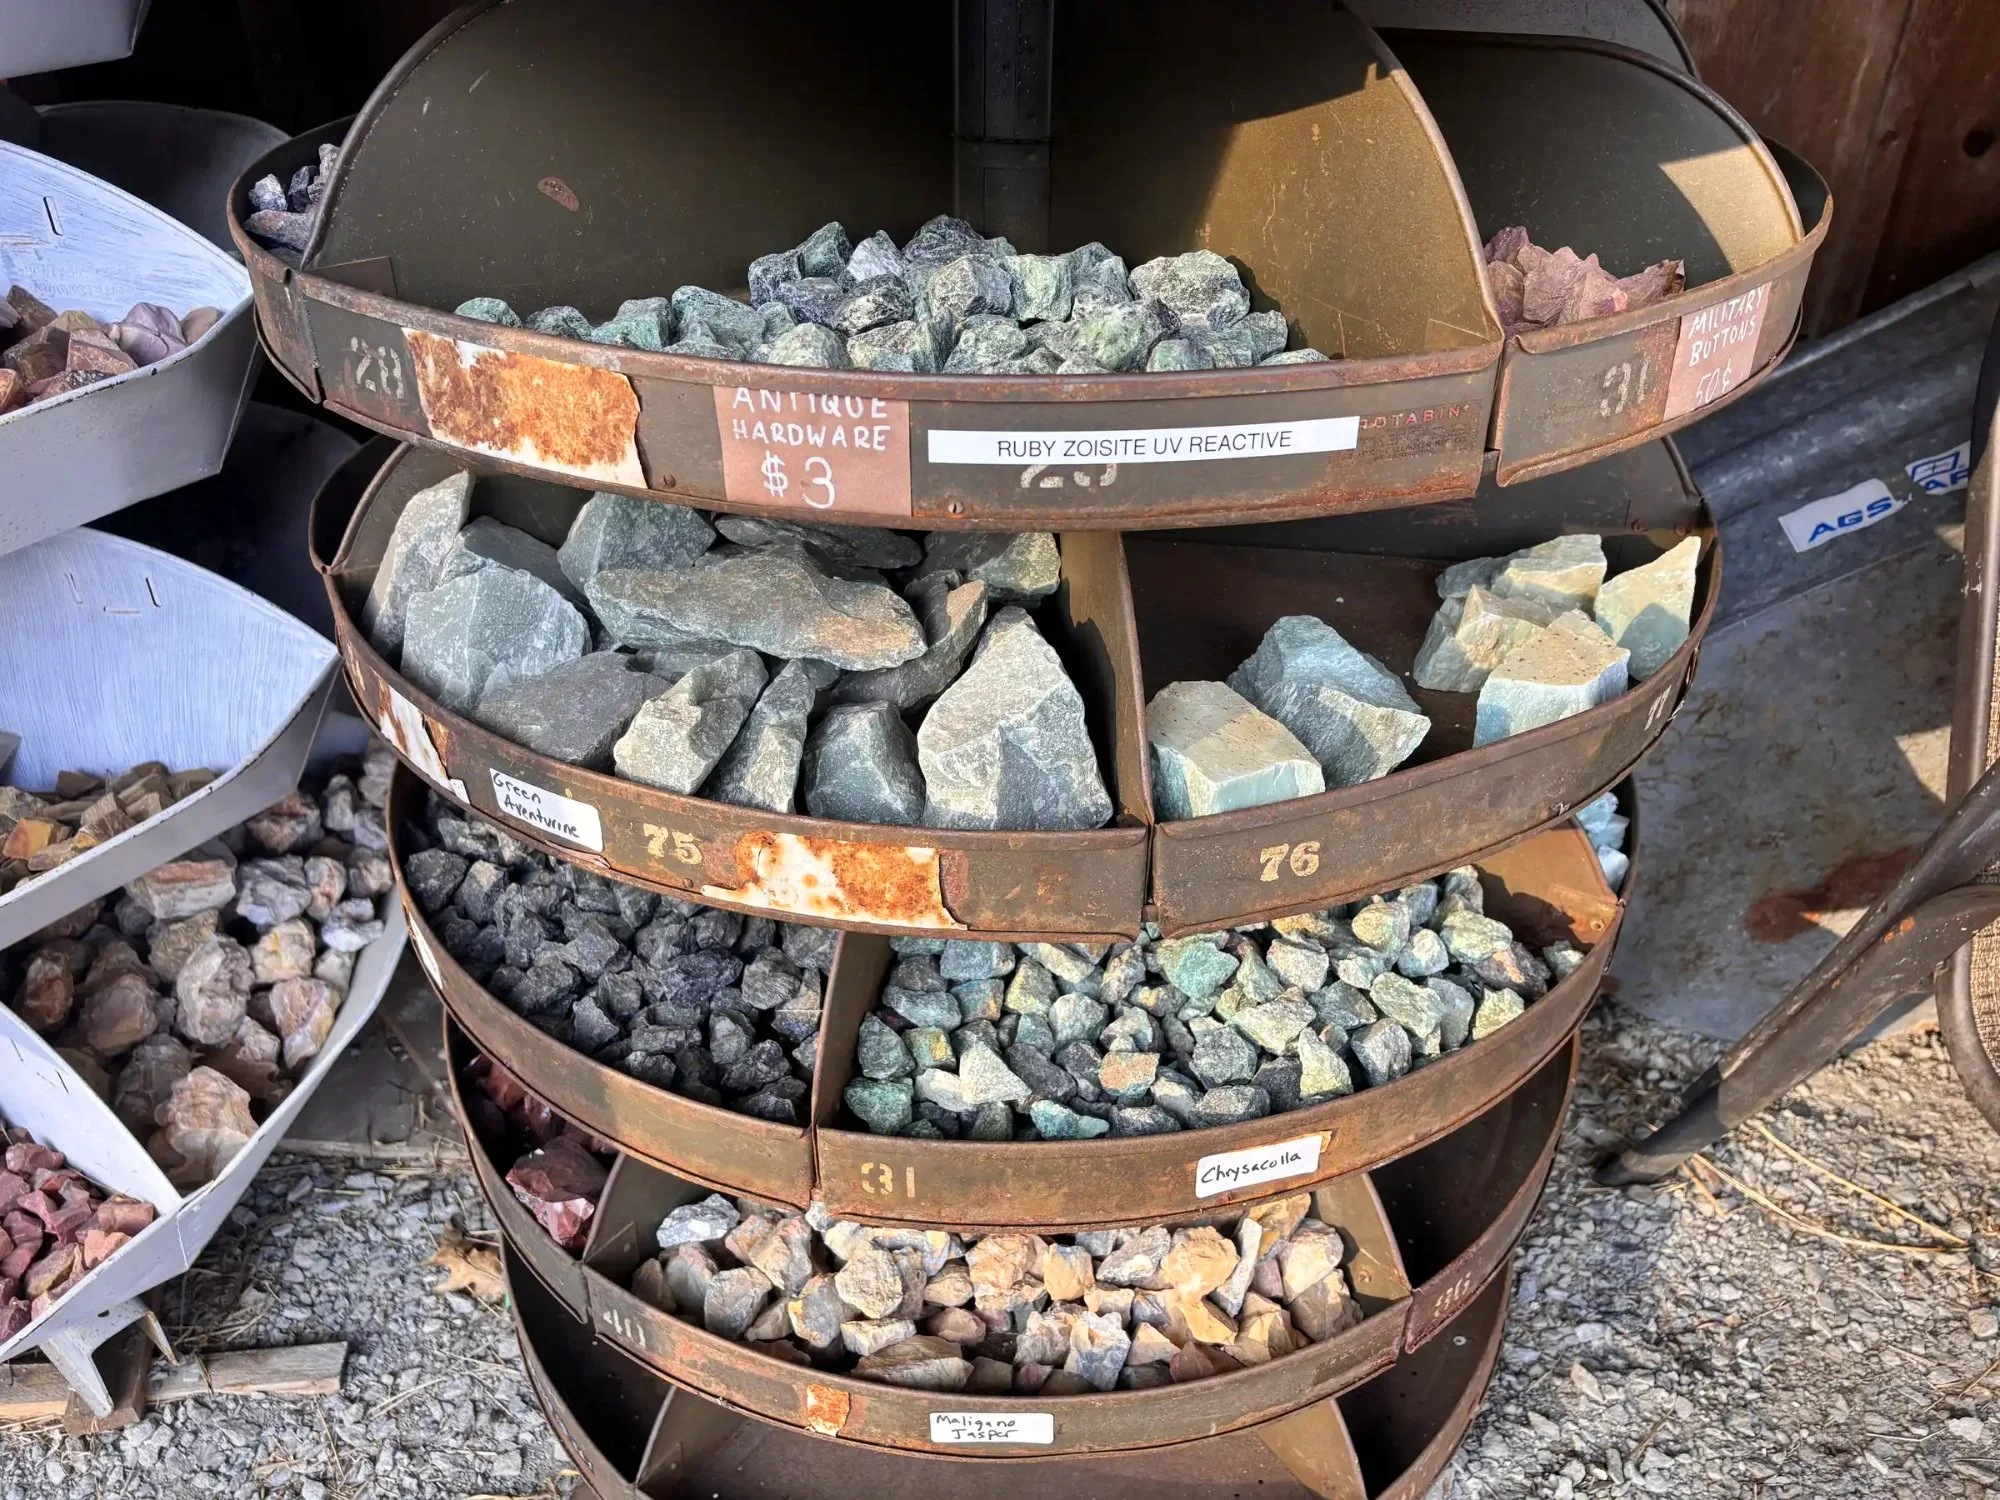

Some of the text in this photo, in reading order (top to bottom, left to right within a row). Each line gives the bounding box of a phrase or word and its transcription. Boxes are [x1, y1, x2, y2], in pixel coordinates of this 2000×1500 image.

[1687, 283, 1766, 339] MILITARY
[1688, 315, 1756, 367] BUTTONS
[732, 386, 888, 418] ANTIQUE
[731, 418, 892, 451] HARDWARE
[996, 430, 1293, 458] RUBY ZOISITE UV REACTIVE
[1808, 496, 1893, 544] AGS
[493, 772, 542, 804] Green
[503, 794, 580, 839] Aventurine
[643, 822, 703, 865] 75
[1259, 840, 1321, 882] 76
[1200, 1151, 1302, 1183] Chrysacolla
[936, 1414, 1017, 1432] Maligano
[951, 1428, 1019, 1441] Jasper
